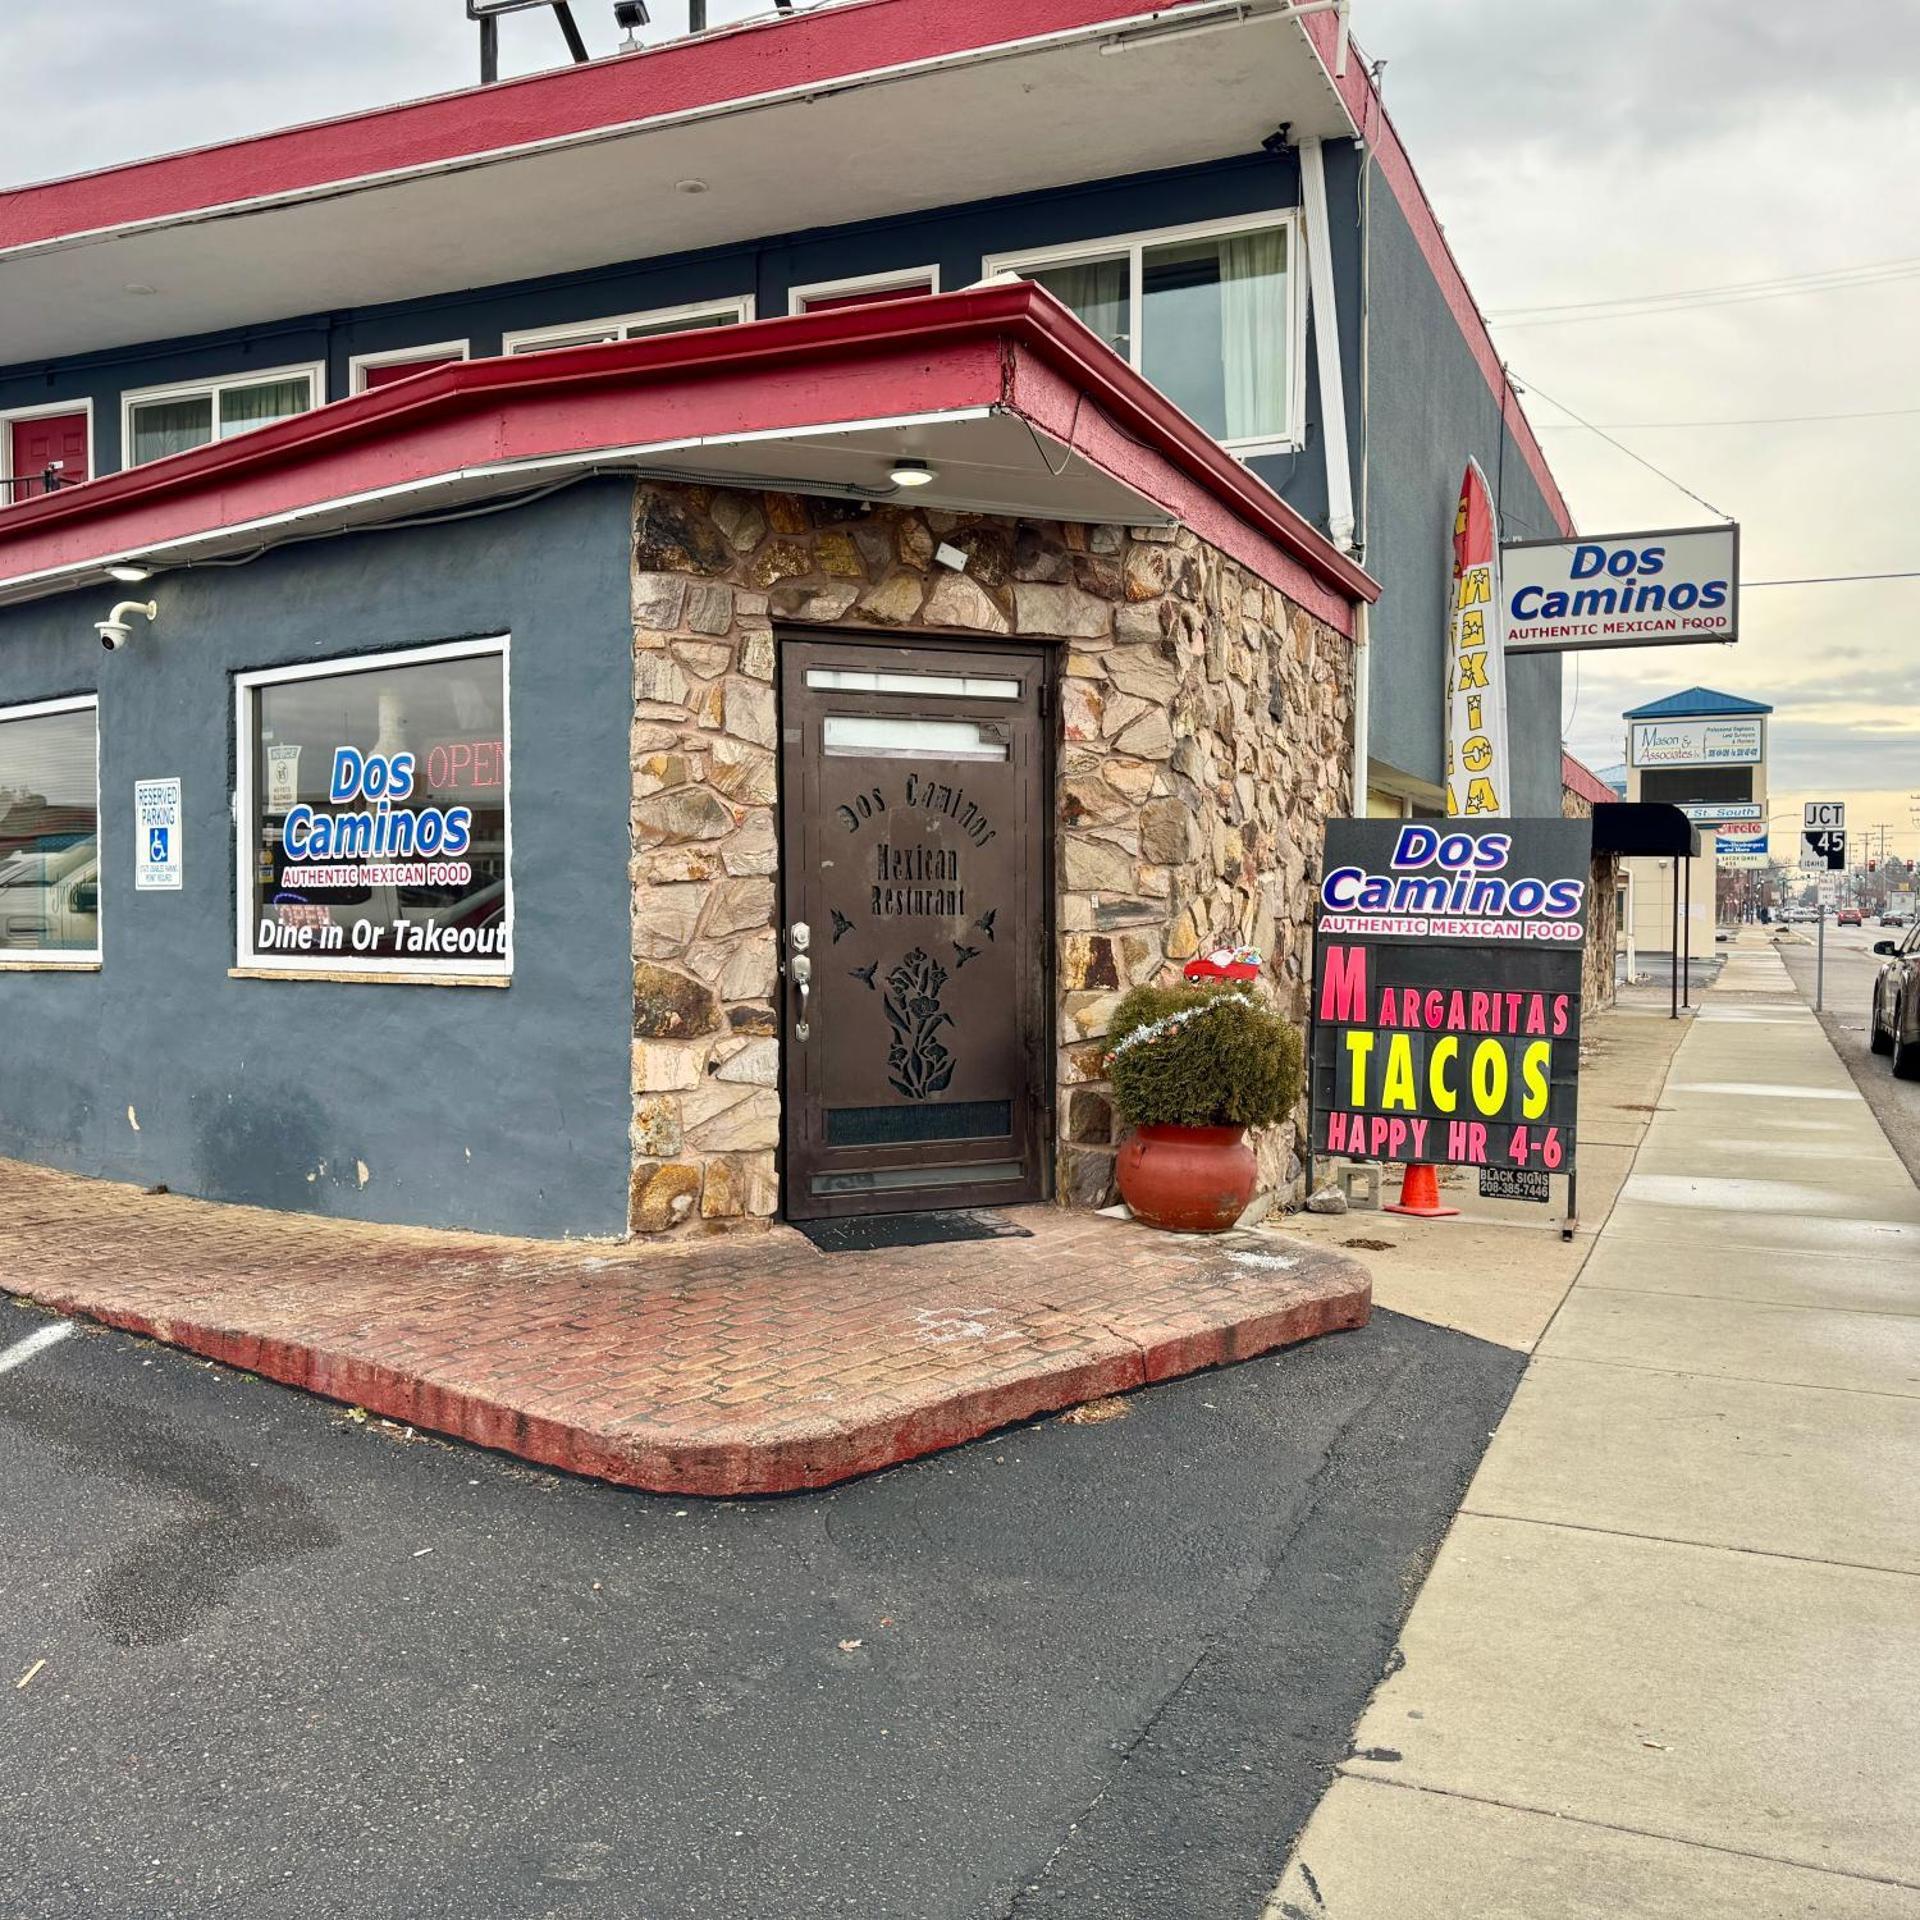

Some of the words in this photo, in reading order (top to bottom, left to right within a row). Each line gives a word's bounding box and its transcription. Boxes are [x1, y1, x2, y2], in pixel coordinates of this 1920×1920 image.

[1570, 544, 1666, 580] Dos
[1510, 578, 1729, 621] Caminos
[1508, 624, 1598, 640] AUTHENTIC
[1603, 619, 1677, 639] MEXICAN
[1682, 616, 1728, 629] FOOD
[1641, 727, 1679, 747] Mason
[1682, 735, 1691, 749] &
[1640, 748, 1692, 761] Associates
[330, 746, 415, 802] Dos
[139, 786, 177, 806] RESERVED
[836, 788, 885, 833] Dos
[906, 773, 996, 847] Caminos
[142, 807, 175, 825] PARKING
[1717, 808, 1755, 817] South
[1806, 805, 1843, 825] JCT
[283, 799, 471, 860] Caminos
[1817, 832, 1844, 851] 45
[877, 843, 957, 881] Mexican
[1391, 824, 1512, 871] Dos
[283, 867, 358, 886] AUTHENTIC
[361, 865, 424, 885] MEXICAN
[429, 863, 470, 883] FOOD
[871, 885, 964, 916] Resturant
[1321, 866, 1585, 917] Caminos
[259, 919, 312, 949] Dine
[319, 922, 342, 949] in
[352, 920, 384, 950] Or
[393, 920, 509, 953] Takeout
[1320, 917, 1427, 935] AUTHENTIC
[1430, 919, 1523, 939] MEXICAN
[1525, 922, 1582, 940] FOOD
[1346, 1031, 1551, 1119] TACOS
[1328, 1112, 1428, 1158] HAPPY
[1448, 1121, 1487, 1163] HR
[1509, 1126, 1562, 1169] 4-6
[1480, 1169, 1515, 1183] BLACK
[1517, 1172, 1548, 1186] SIGNS
